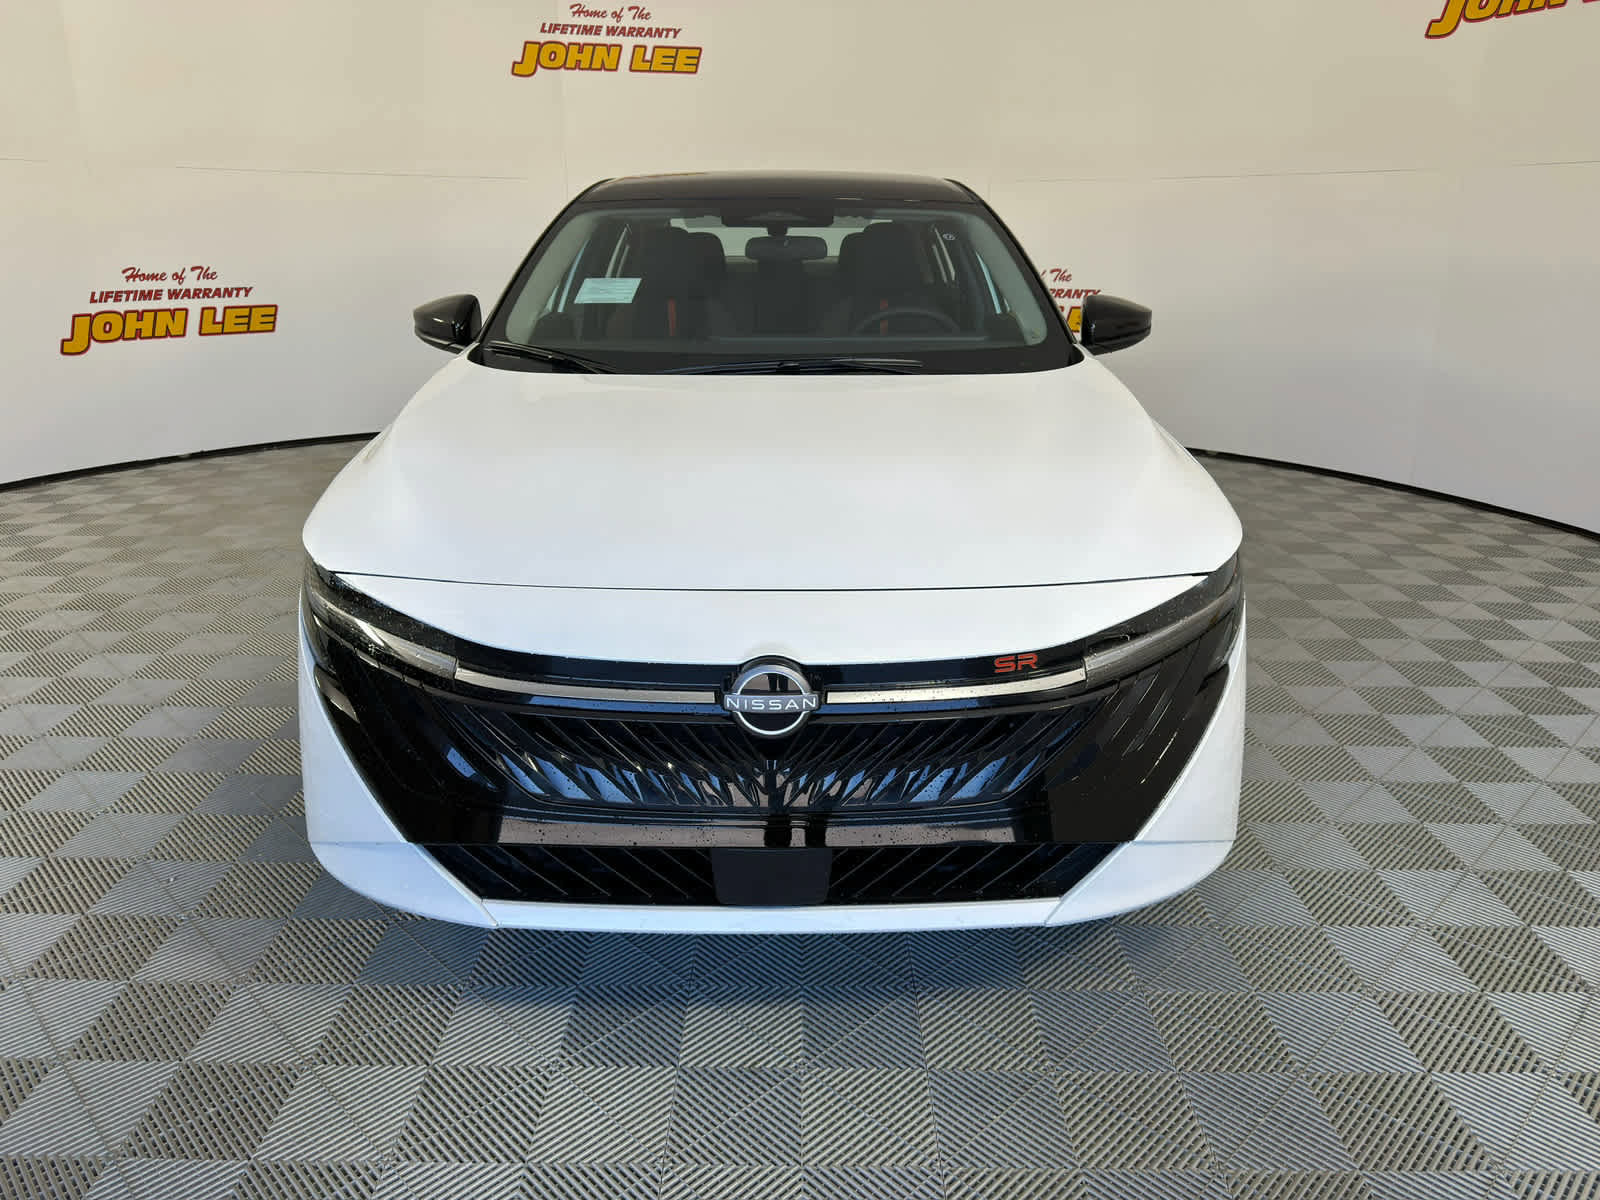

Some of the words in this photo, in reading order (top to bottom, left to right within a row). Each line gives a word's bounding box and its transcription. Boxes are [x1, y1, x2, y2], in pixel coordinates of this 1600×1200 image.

[569, 3, 607, 19] Home
[611, 7, 625, 23] of
[628, 5, 652, 21] The
[1425, 0, 1567, 39] JO
[540, 22, 603, 36] LIFETIME
[605, 25, 682, 39] WARRANTY
[511, 40, 623, 78] JOHN
[629, 44, 703, 75] LEE
[121, 266, 168, 283] Home
[171, 267, 186, 285] of
[190, 265, 218, 282] The
[1050, 268, 1072, 282] The
[89, 288, 163, 304] LIFETIME
[167, 286, 254, 301] WARRANTY
[1049, 288, 1101, 299] RANTY
[60, 307, 189, 356] JOHN
[198, 304, 278, 336] LEE
[994, 652, 1038, 673] SR
[726, 696, 817, 711] NISSAN
